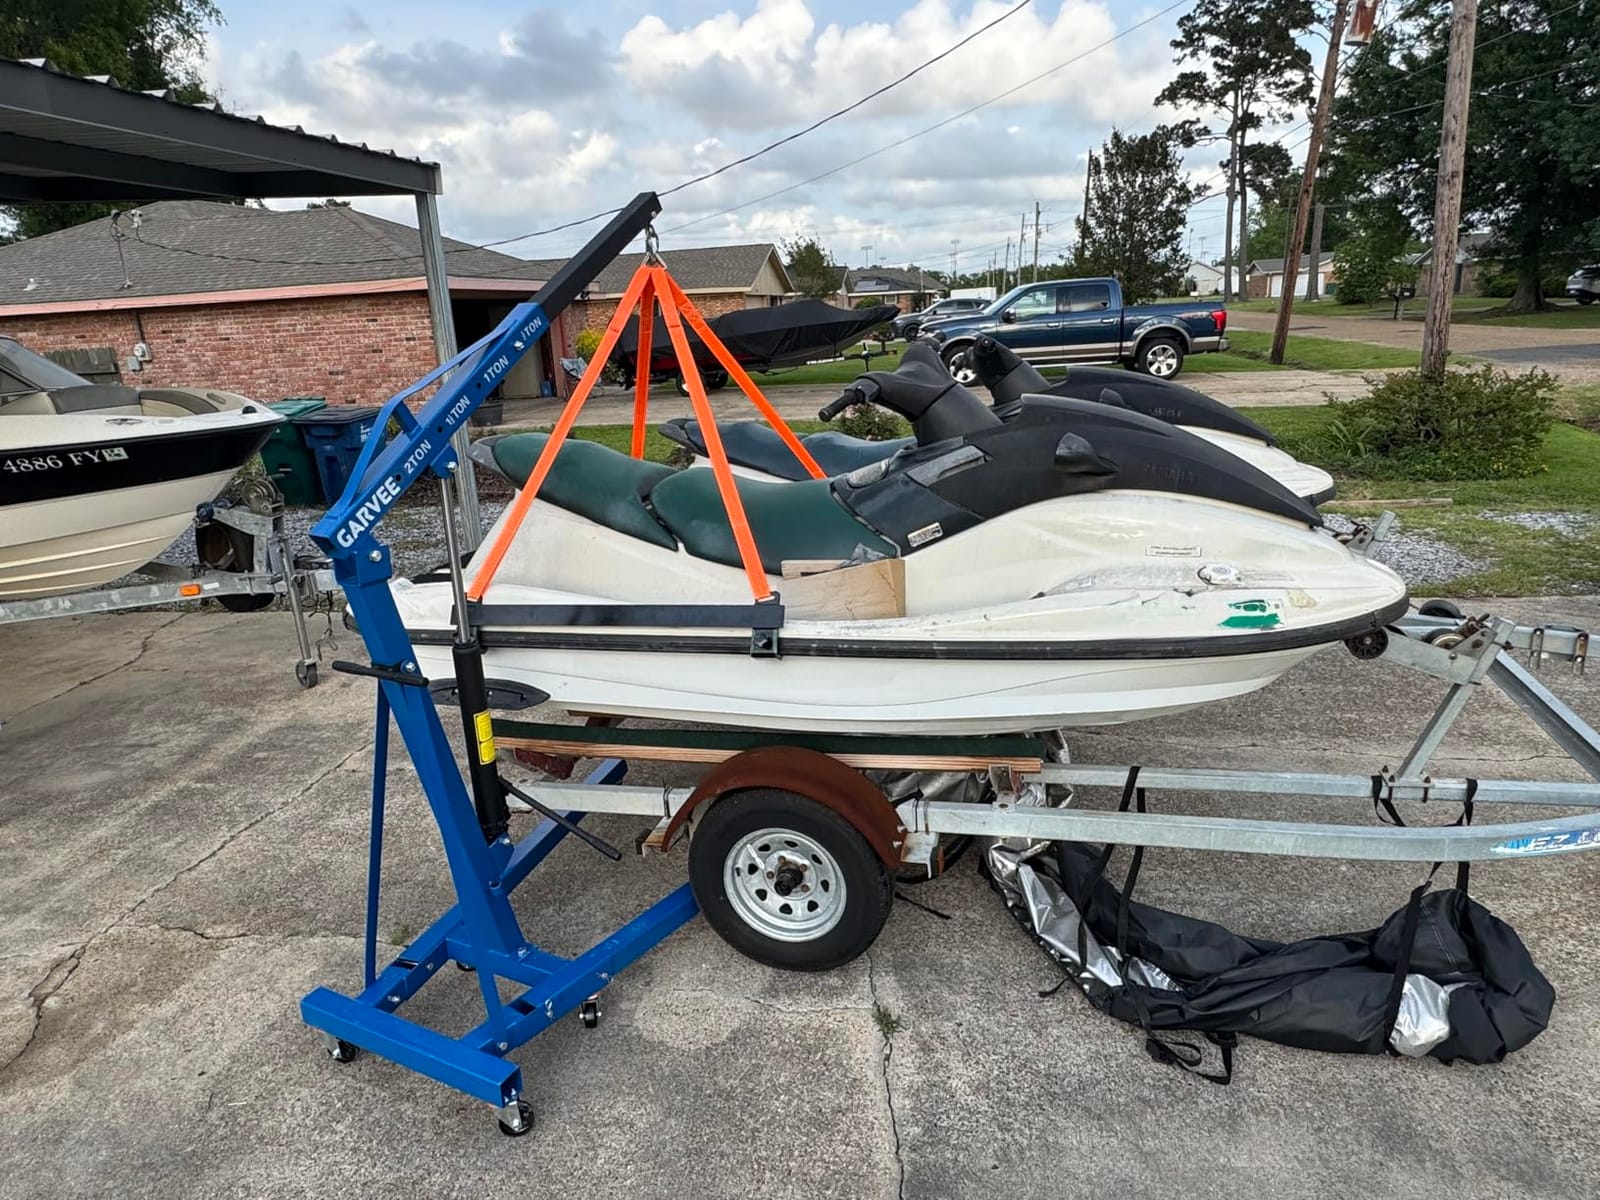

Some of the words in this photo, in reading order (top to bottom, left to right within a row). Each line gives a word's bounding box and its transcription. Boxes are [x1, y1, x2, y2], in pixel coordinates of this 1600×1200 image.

[483, 354, 510, 385] 1TON
[3, 456, 63, 473] 4886
[68, 450, 102, 466] FY
[403, 439, 432, 475] 2TON
[336, 476, 401, 548] GARVEE
